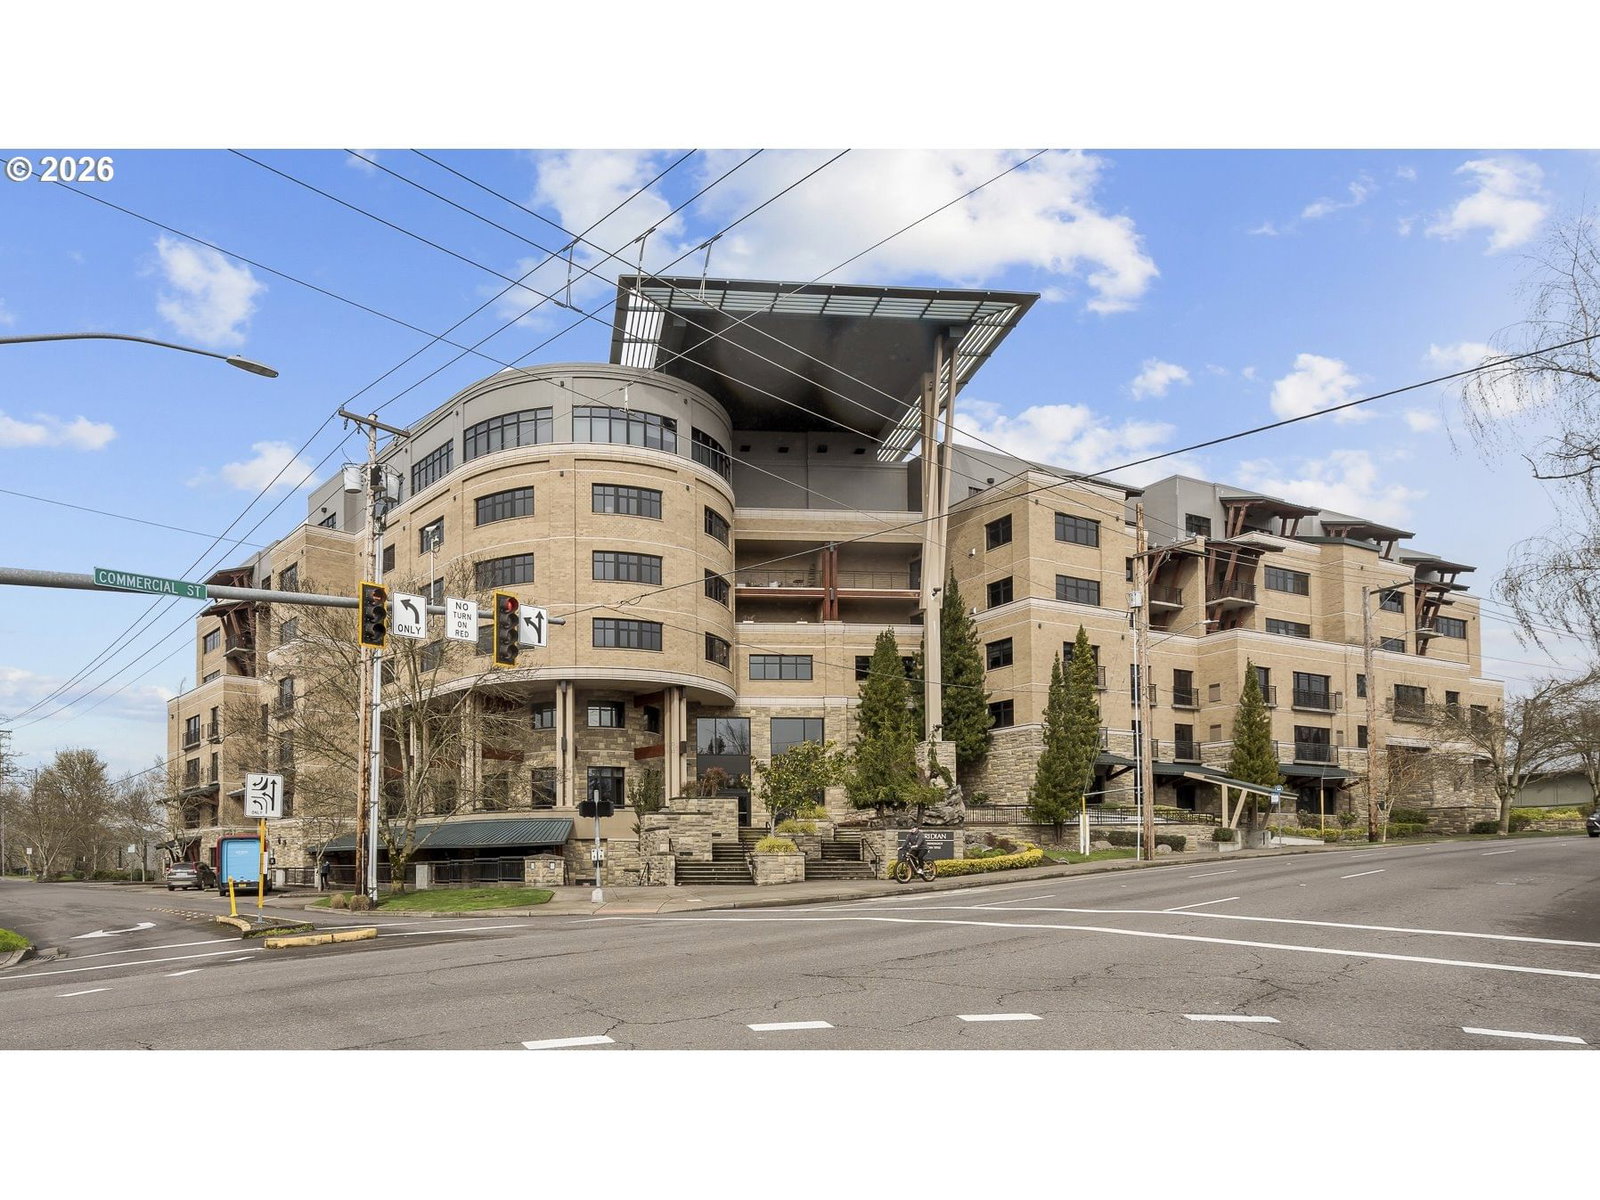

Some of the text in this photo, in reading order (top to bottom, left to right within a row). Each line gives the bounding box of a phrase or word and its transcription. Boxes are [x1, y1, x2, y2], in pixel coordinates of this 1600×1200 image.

[99, 571, 202, 597] COMMERCIAL ST
[455, 602, 469, 611] NO
[453, 611, 472, 620] TURN
[397, 623, 422, 635] ONLY
[457, 621, 468, 629] ON
[455, 630, 470, 638] RED
